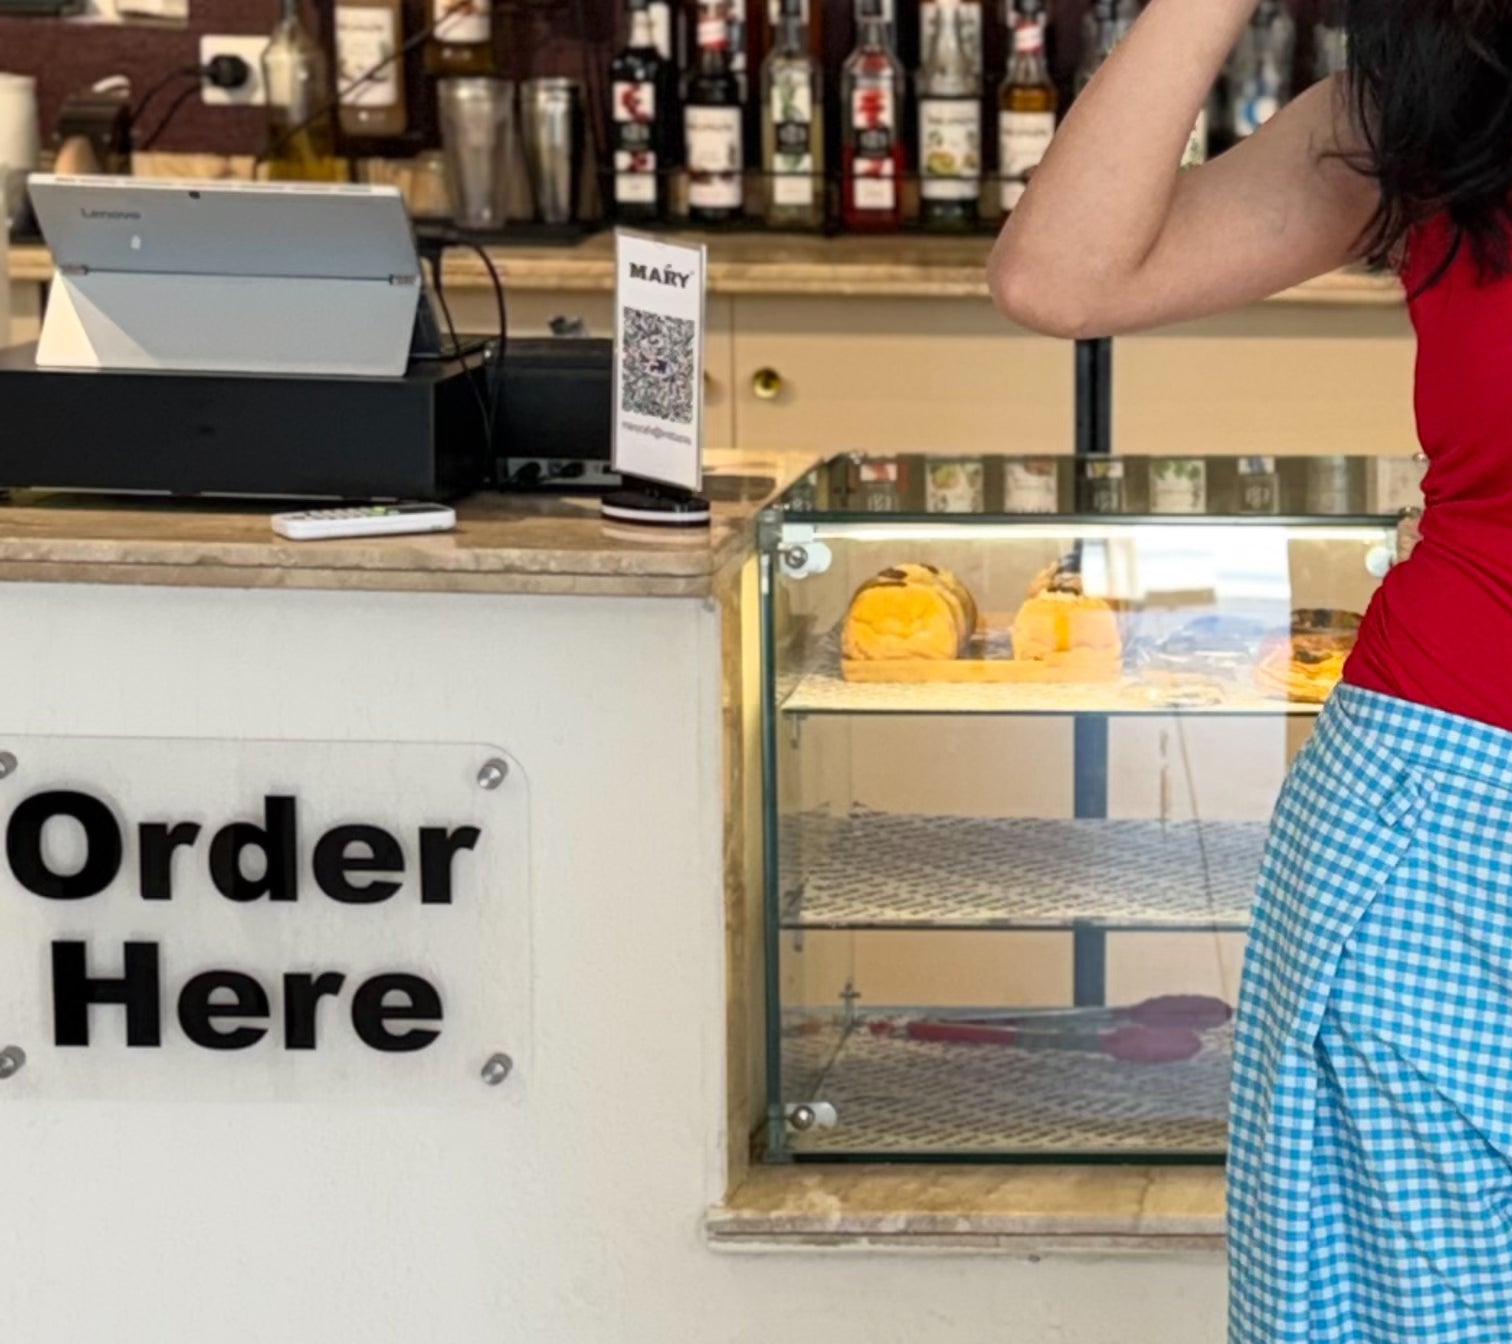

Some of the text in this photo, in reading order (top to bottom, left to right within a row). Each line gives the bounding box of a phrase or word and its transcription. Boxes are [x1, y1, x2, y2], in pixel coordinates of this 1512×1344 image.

[80, 207, 142, 220] Lenovo
[5, 789, 482, 904] Order
[50, 939, 445, 1053] Here
